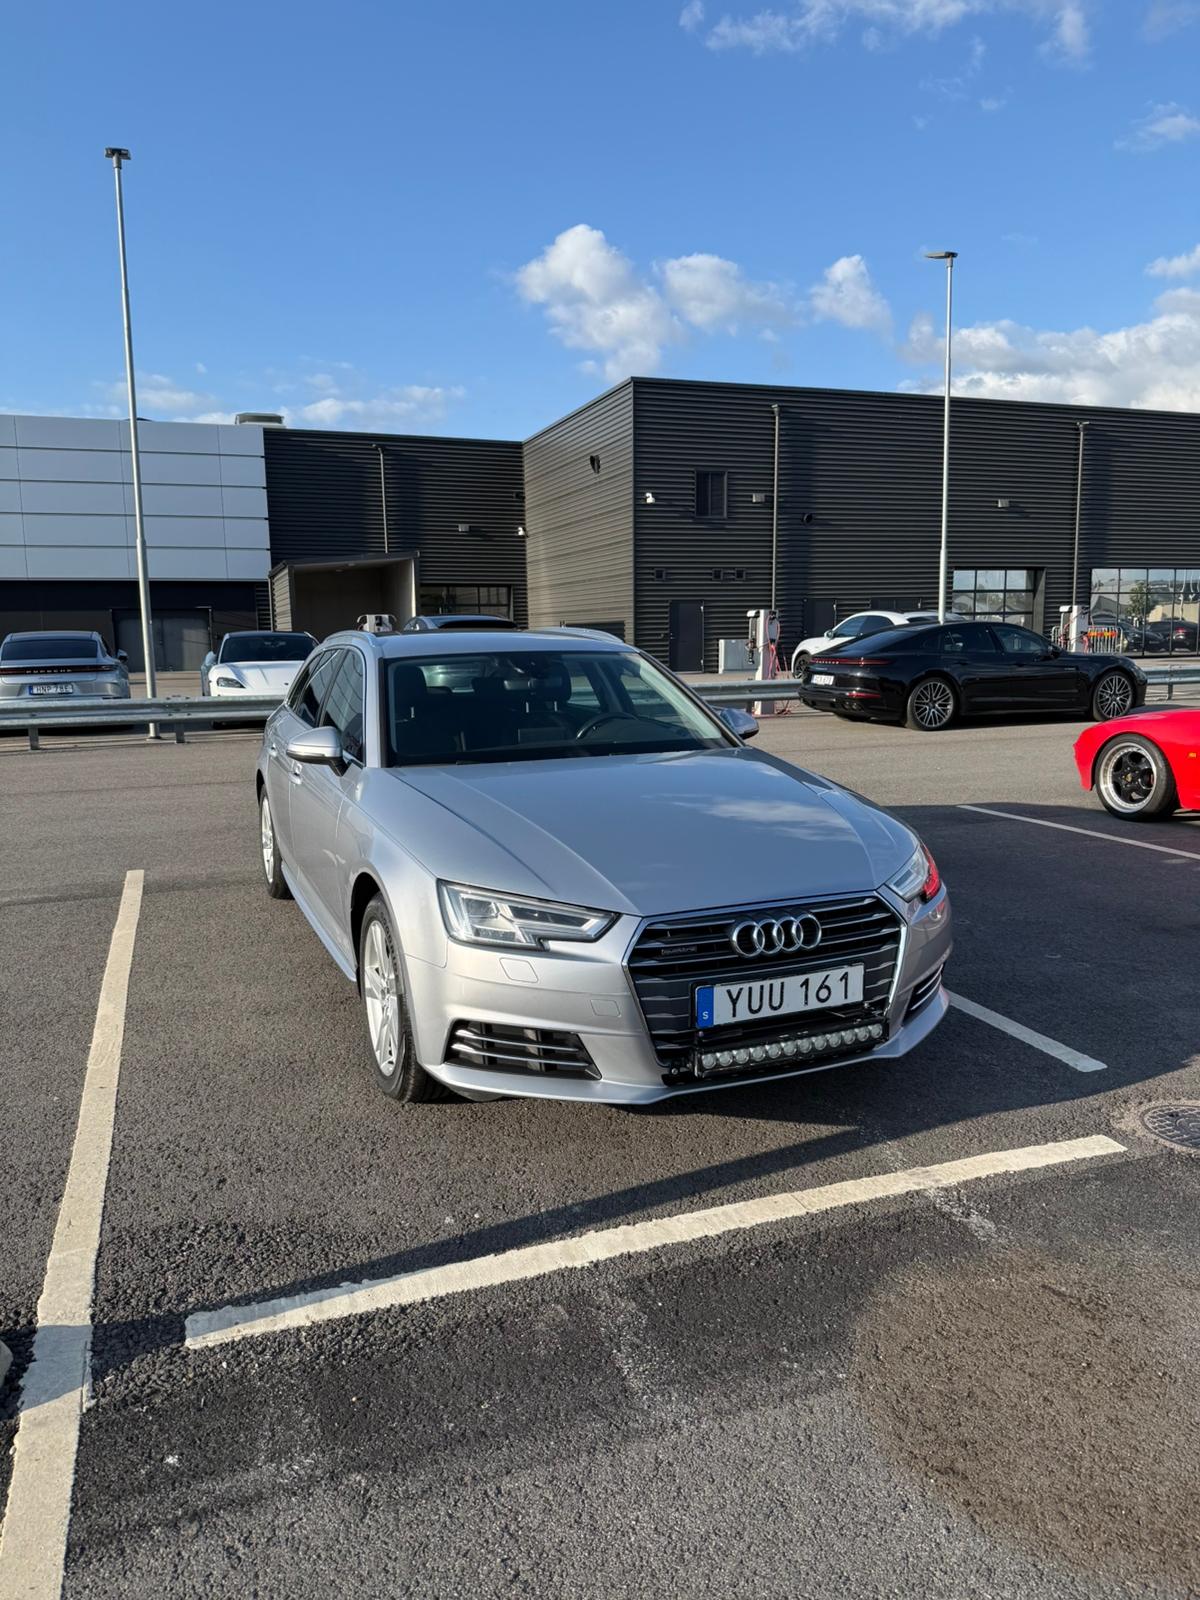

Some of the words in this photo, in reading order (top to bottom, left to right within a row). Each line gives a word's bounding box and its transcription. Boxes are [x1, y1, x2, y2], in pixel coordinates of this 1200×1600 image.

[36, 685, 52, 693] HNP
[726, 981, 785, 1018] YUU
[799, 971, 849, 1007] 161
[702, 1011, 709, 1020] S
